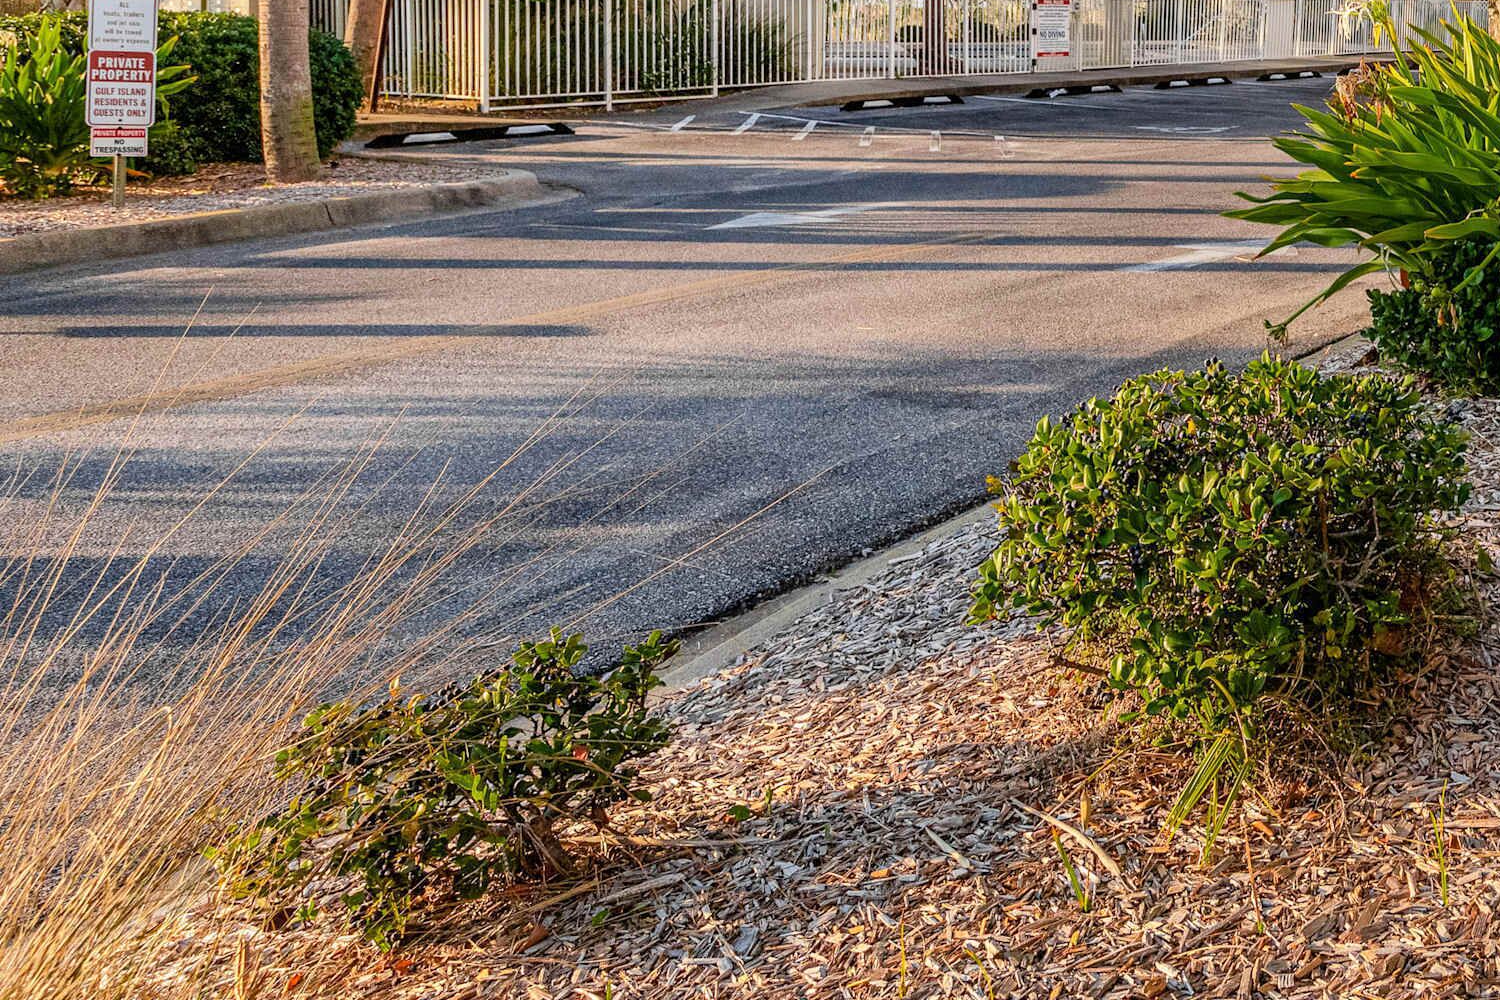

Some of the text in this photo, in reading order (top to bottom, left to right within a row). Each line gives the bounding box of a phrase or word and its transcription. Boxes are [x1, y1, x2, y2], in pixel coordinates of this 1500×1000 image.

[97, 57, 145, 69] PRIVATE
[91, 69, 152, 81] PROPERTY
[95, 87, 146, 96] GULF ISLAND
[94, 98, 138, 106] RESIDENTS
[94, 108, 146, 117] GUESTS ONLY
[95, 146, 144, 154] TRESPASSING
